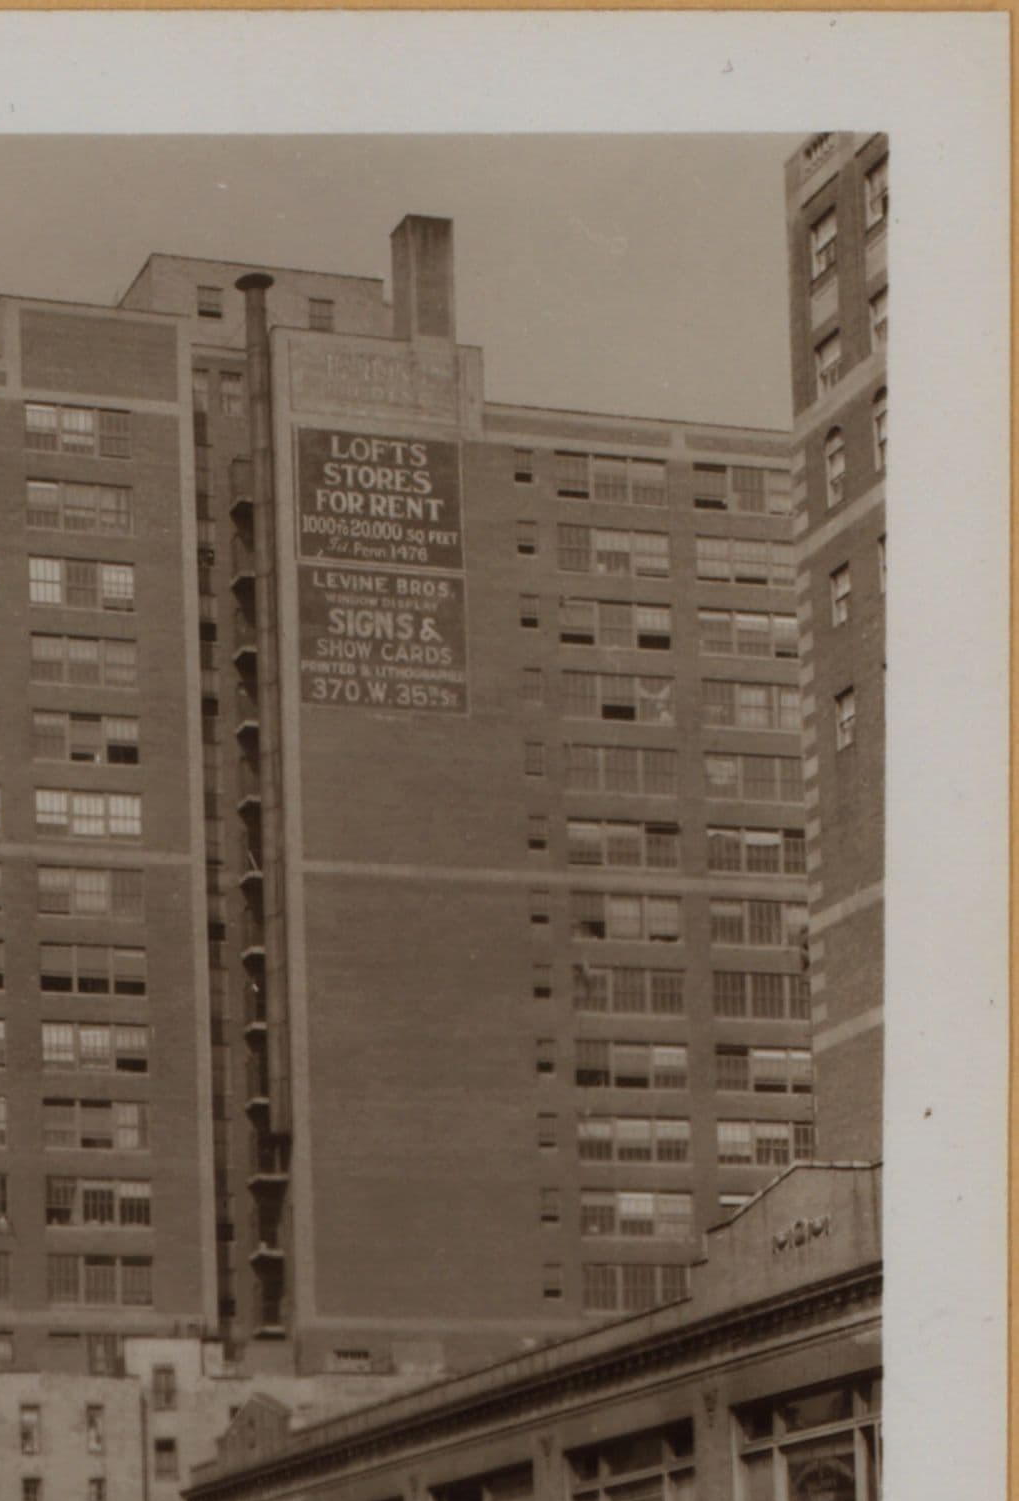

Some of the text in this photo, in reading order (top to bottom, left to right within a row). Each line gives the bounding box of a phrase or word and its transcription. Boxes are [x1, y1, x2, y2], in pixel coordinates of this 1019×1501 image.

[331, 435, 428, 467] LOFTS
[323, 462, 433, 495] STORES
[316, 489, 445, 522] FOR RENT
[302, 515, 336, 534] 1000
[428, 531, 459, 545] FEET
[312, 570, 456, 599] LEVINE BROS.
[325, 592, 439, 612] WINDOW DISPLAY
[327, 607, 444, 643] SIGNS &
[316, 637, 453, 666] SHOW CARDS
[300, 659, 356, 676] PRINTED
[311, 677, 361, 702] 370
